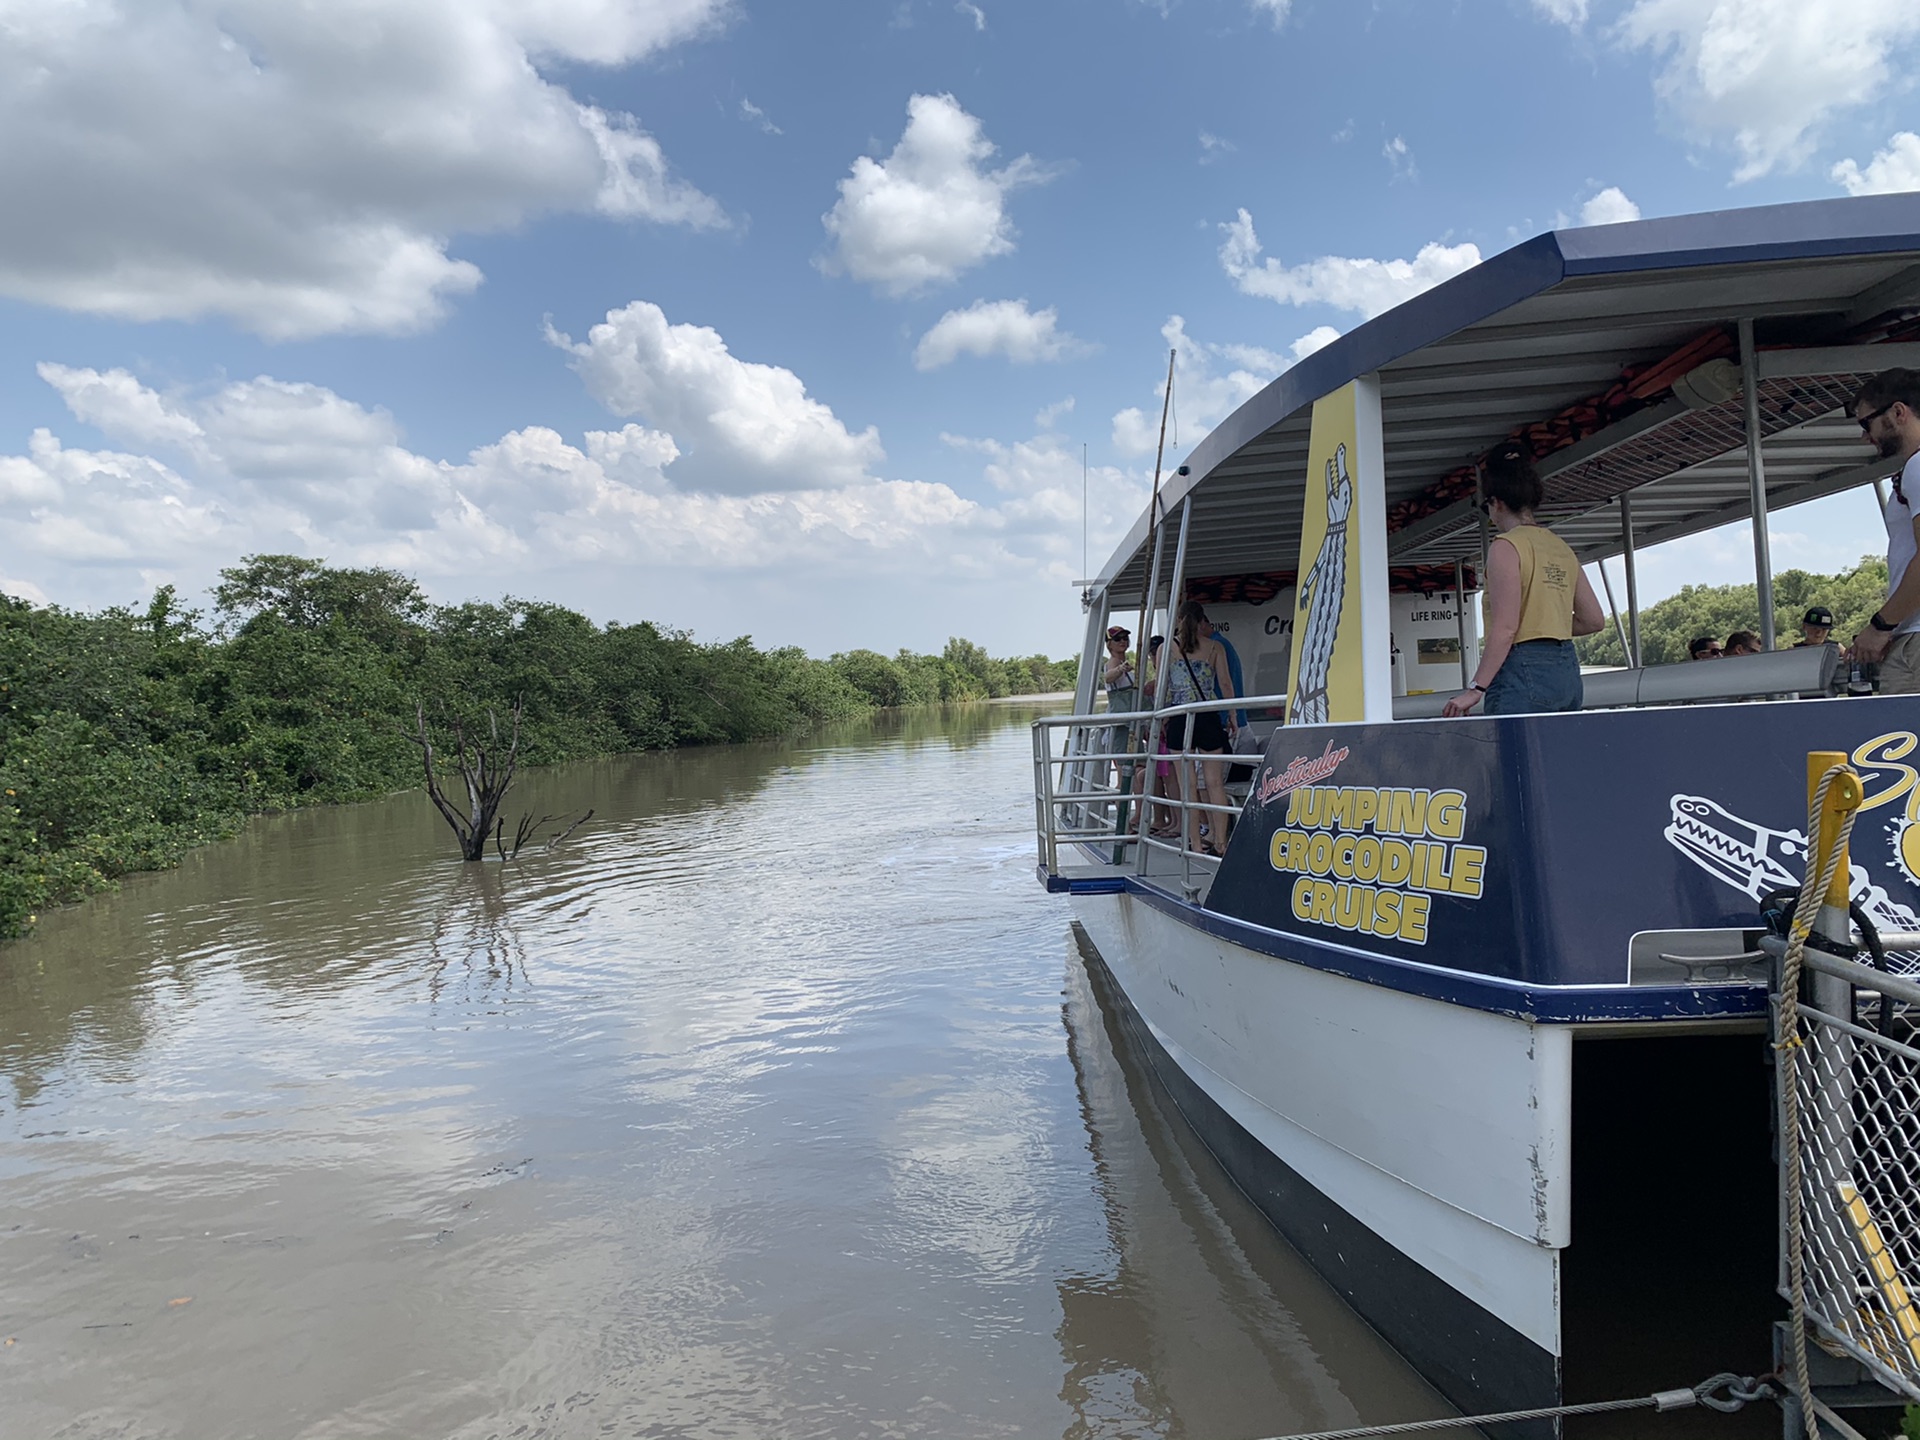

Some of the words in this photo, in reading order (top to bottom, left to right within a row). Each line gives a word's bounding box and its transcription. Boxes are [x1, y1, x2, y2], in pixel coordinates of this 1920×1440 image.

[1411, 611, 1429, 621] LIFE
[1431, 610, 1452, 621] RING
[1257, 739, 1350, 808] Spectacular
[1286, 786, 1467, 841] JUMPING
[1269, 828, 1487, 899] CROCODILE
[1291, 876, 1431, 945] CRUISE
